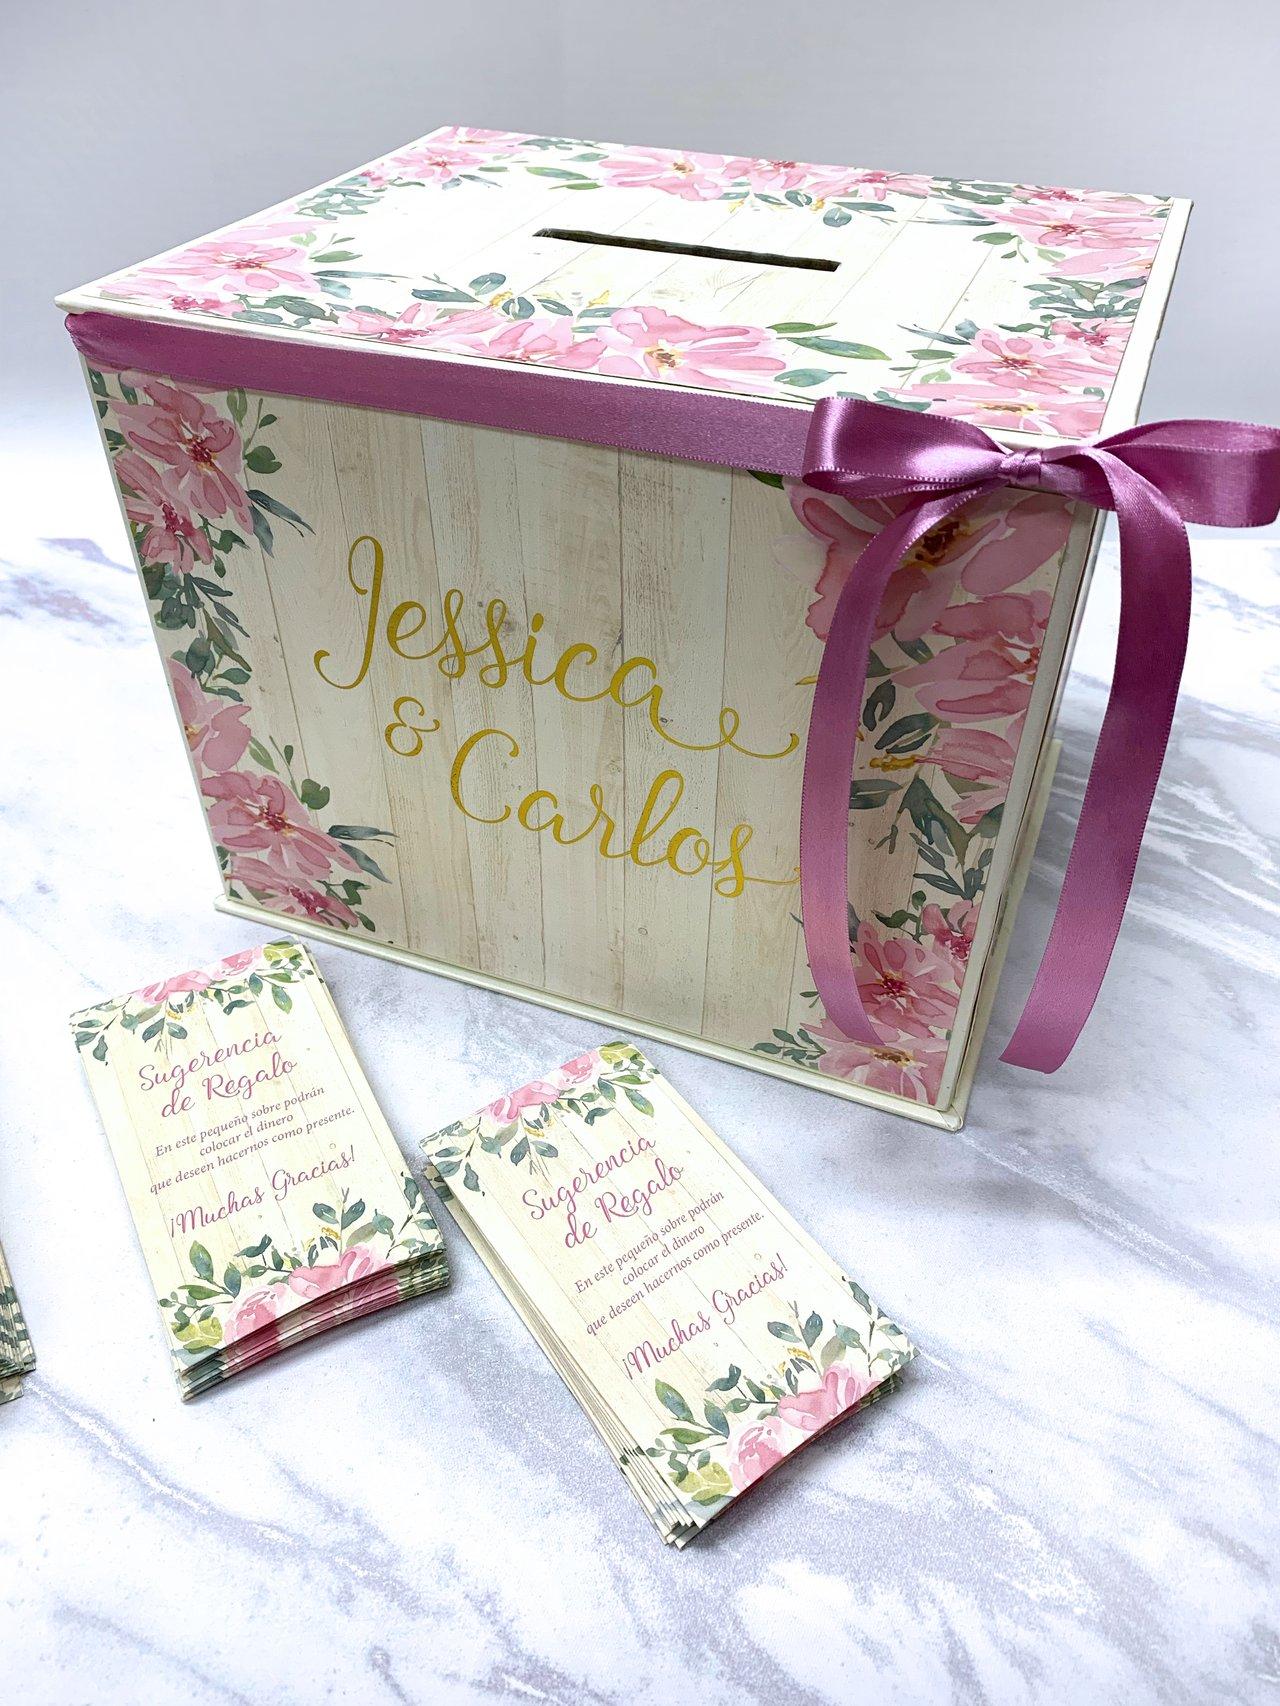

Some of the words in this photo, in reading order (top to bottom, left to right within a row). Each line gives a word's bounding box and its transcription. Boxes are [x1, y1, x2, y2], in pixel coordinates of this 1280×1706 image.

[313, 535, 800, 760] Jessica
[384, 696, 440, 757] &
[450, 728, 801, 898] Carlos
[139, 1032, 282, 1091] Sugerencia
[162, 1087, 195, 1117] de
[202, 1052, 297, 1100] Regalo
[150, 1178, 172, 1195] que
[175, 1160, 215, 1183] deseen
[217, 1139, 269, 1167] hacernos
[272, 1127, 303, 1143] como
[306, 1107, 355, 1134] presente.
[155, 1144, 172, 1157] En
[175, 1134, 197, 1148] este
[200, 1115, 248, 1142] pequeño
[251, 1102, 281, 1118] sobre
[284, 1086, 324, 1110] podrán
[199, 1133, 241, 1156] colocar
[245, 1125, 253, 1138] el
[257, 1114, 293, 1133] dinero
[171, 1187, 264, 1237] ¡Muchas
[272, 1144, 355, 1201] Gracias!
[522, 1138, 656, 1220] Sugerencia
[565, 1213, 597, 1248] de
[594, 1158, 684, 1223] Regalo
[574, 1272, 593, 1293] En
[594, 1263, 614, 1281] este
[616, 1233, 658, 1271] pequeño
[660, 1214, 687, 1236] sobre
[688, 1191, 724, 1222] podrán
[586, 1316, 608, 1336] que
[608, 1290, 644, 1319] deseen
[643, 1258, 692, 1294] hacernos
[693, 1239, 720, 1260] como
[722, 1211, 764, 1245] presente.
[622, 1255, 659, 1285] colocar
[662, 1243, 671, 1258] el
[672, 1225, 705, 1251] dinero
[622, 1311, 711, 1380] ¡Muchas
[712, 1253, 788, 1325] Gracias!
